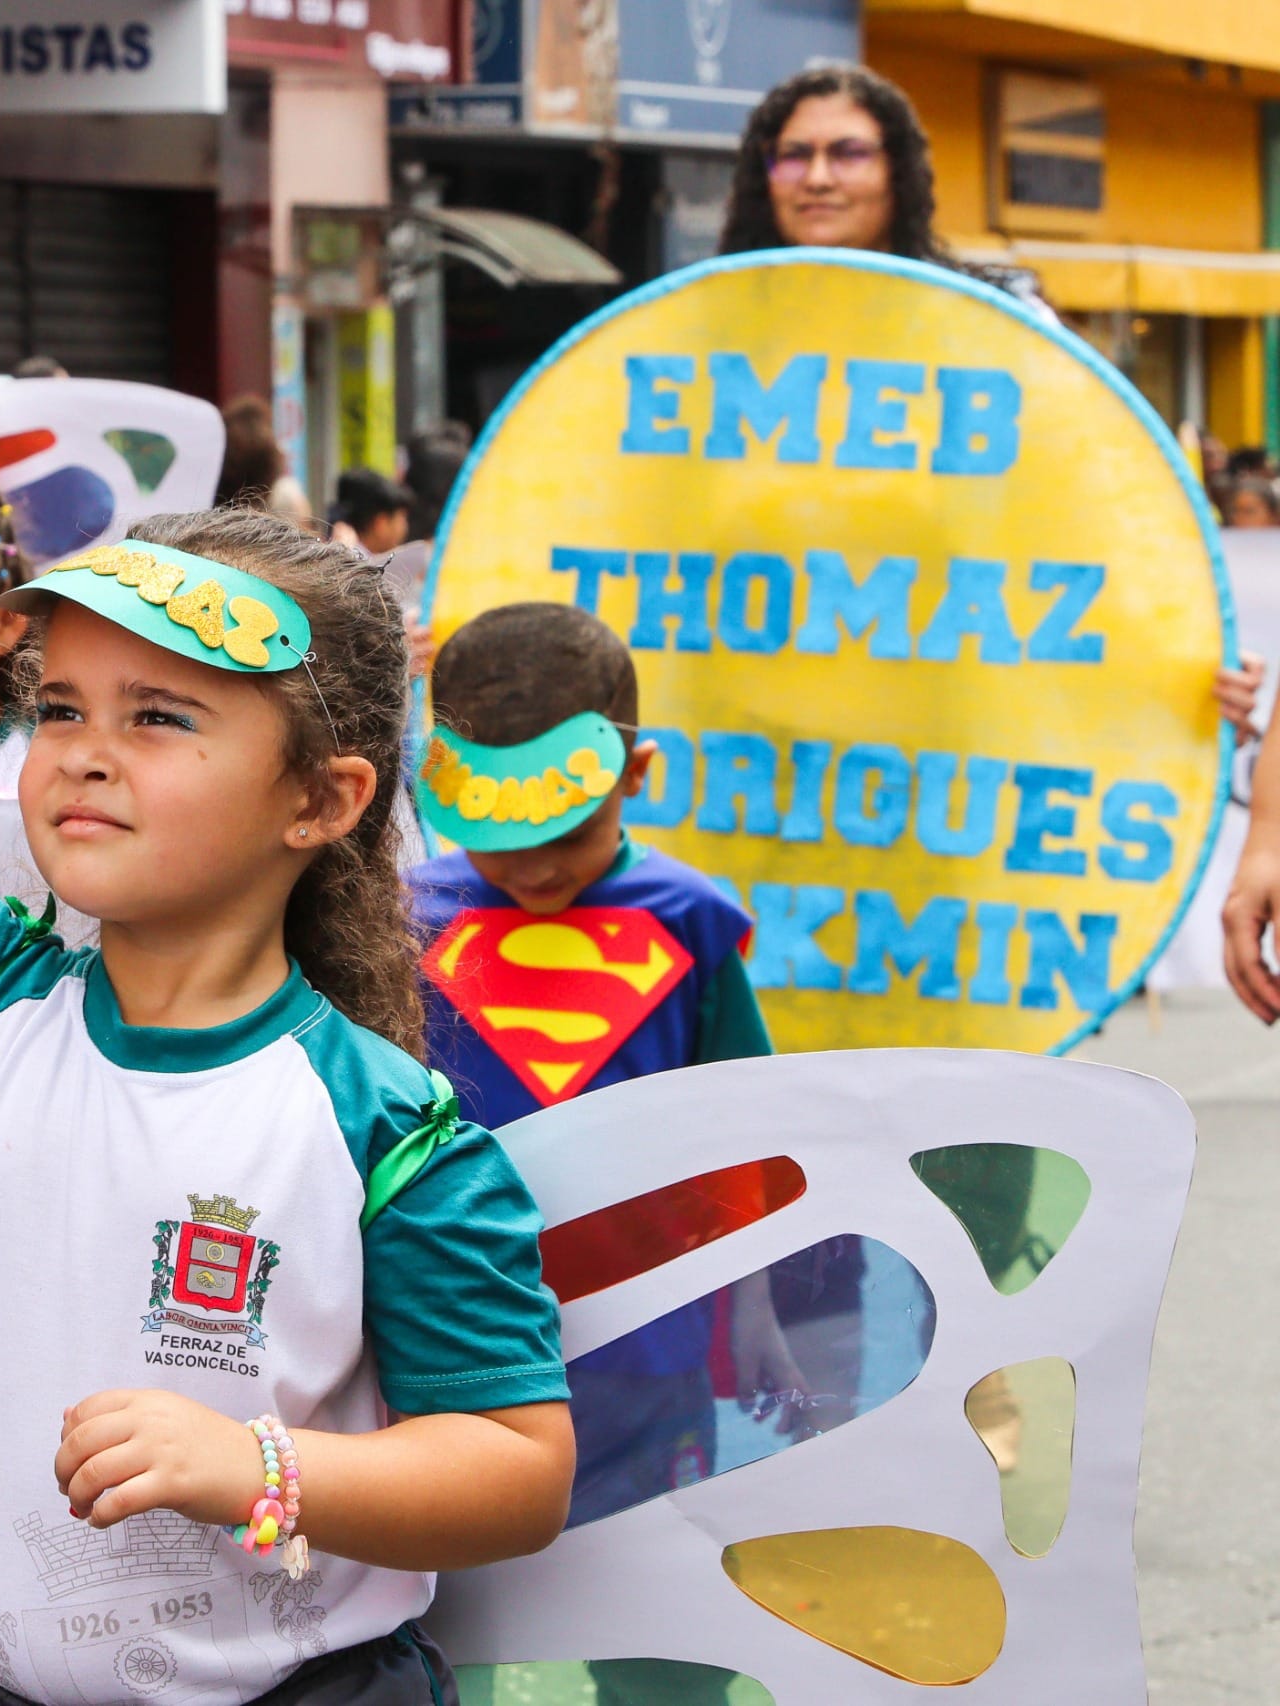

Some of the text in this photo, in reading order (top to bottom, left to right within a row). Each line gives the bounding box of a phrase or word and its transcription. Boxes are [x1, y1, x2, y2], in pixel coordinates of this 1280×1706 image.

[619, 352, 1023, 476] EMEB
[550, 545, 1107, 665] THOMAZ
[620, 726, 1179, 884] DRIGUES
[144, 1350, 260, 1378] VASCONCELOS
[160, 1334, 247, 1358] FERRAZ DE
[56, 1609, 121, 1643] 1926
[149, 1591, 214, 1626] 1953
